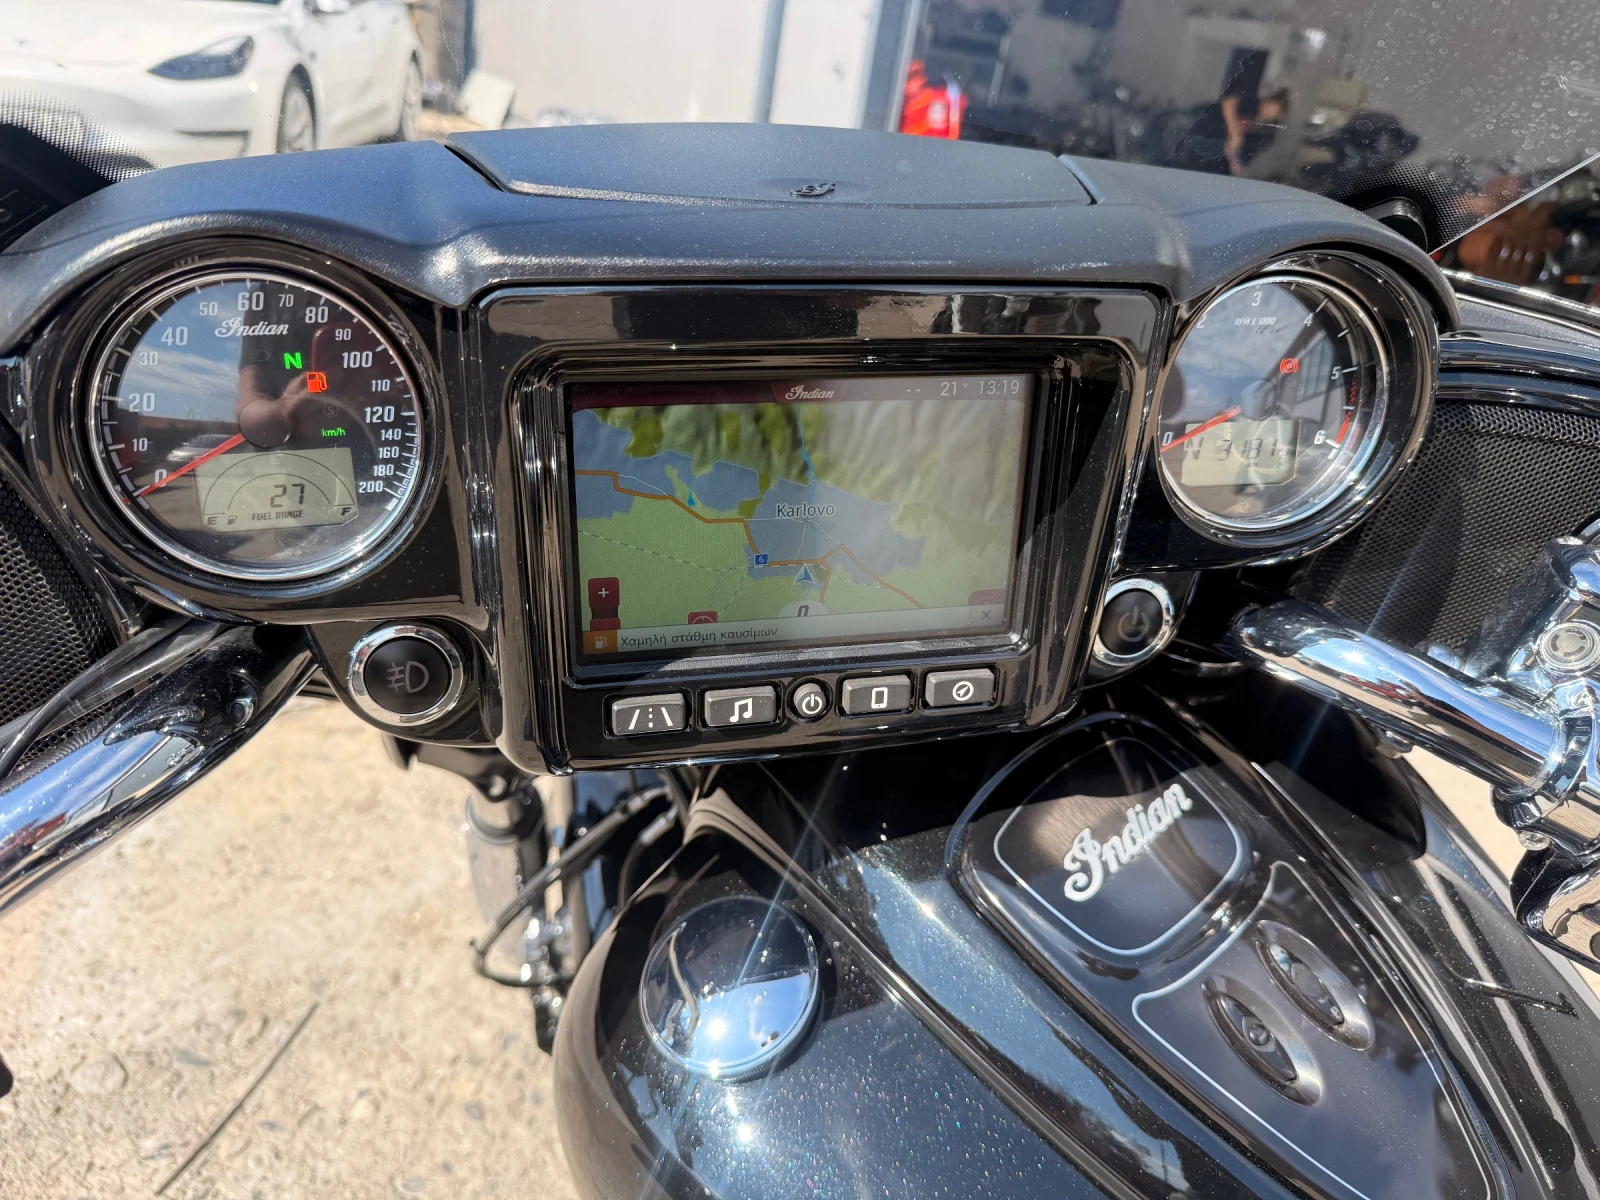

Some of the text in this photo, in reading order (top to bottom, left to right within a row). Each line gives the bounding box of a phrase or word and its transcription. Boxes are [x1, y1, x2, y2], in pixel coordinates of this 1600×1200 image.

[237, 291, 264, 311] 60
[278, 294, 294, 307] 70
[1251, 291, 1262, 306] 3
[199, 302, 218, 316] 50
[305, 306, 329, 323] 80
[215, 317, 288, 337] Indian
[1234, 316, 1250, 326] RPM
[1257, 316, 1276, 326] 1000
[1303, 312, 1315, 327] 4
[161, 326, 188, 346] 40
[335, 329, 352, 342] 90
[139, 352, 159, 366] 30
[284, 352, 303, 369] N
[342, 351, 373, 369] 100
[1330, 366, 1341, 380] 5
[371, 379, 390, 392] 110
[785, 385, 835, 401] Indian
[978, 380, 1020, 396] 13:19
[128, 393, 155, 412] 20
[365, 406, 394, 423] 120
[321, 427, 346, 438] km/h
[380, 428, 402, 441] 140
[1162, 431, 1173, 446] 0
[1313, 430, 1326, 445] 6
[132, 438, 148, 452] 10
[378, 446, 399, 459] 160
[154, 469, 167, 487] 0
[373, 464, 394, 477] 180
[358, 480, 384, 493] 200
[270, 483, 305, 508] 27
[251, 509, 304, 521] FUEL RANGE
[341, 506, 352, 517] F
[776, 502, 836, 519] Karlovo
[207, 515, 218, 526] E
[620, 626, 778, 649] Χαμηλή στάθμη καυσίμων
[1063, 783, 1193, 902] Indian
